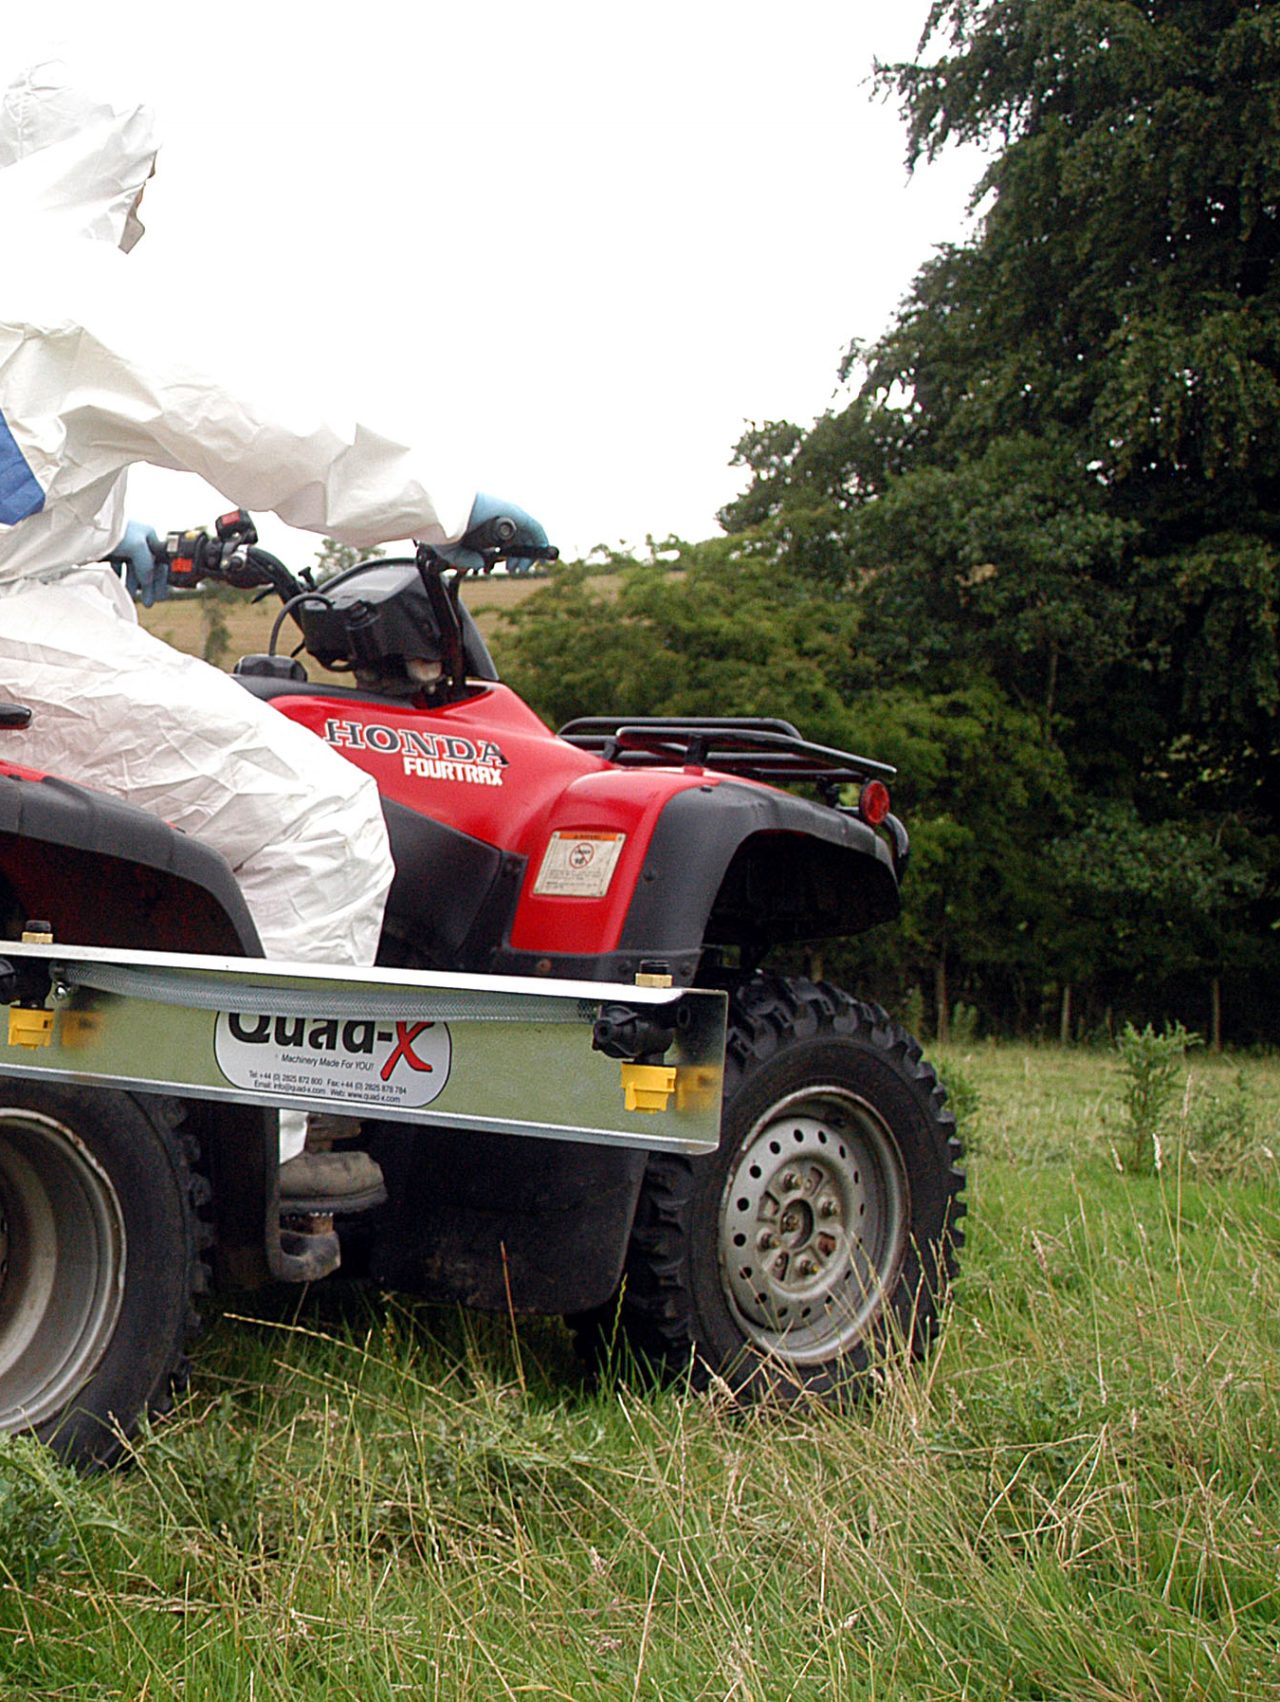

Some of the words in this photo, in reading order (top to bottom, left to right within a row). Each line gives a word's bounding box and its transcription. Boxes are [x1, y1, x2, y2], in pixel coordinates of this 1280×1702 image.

[323, 718, 510, 767] HONDA
[403, 757, 503, 786] FOURTRAX
[281, 1053, 318, 1067] Machinery
[319, 1057, 340, 1067] Made
[341, 1059, 354, 1069] For
